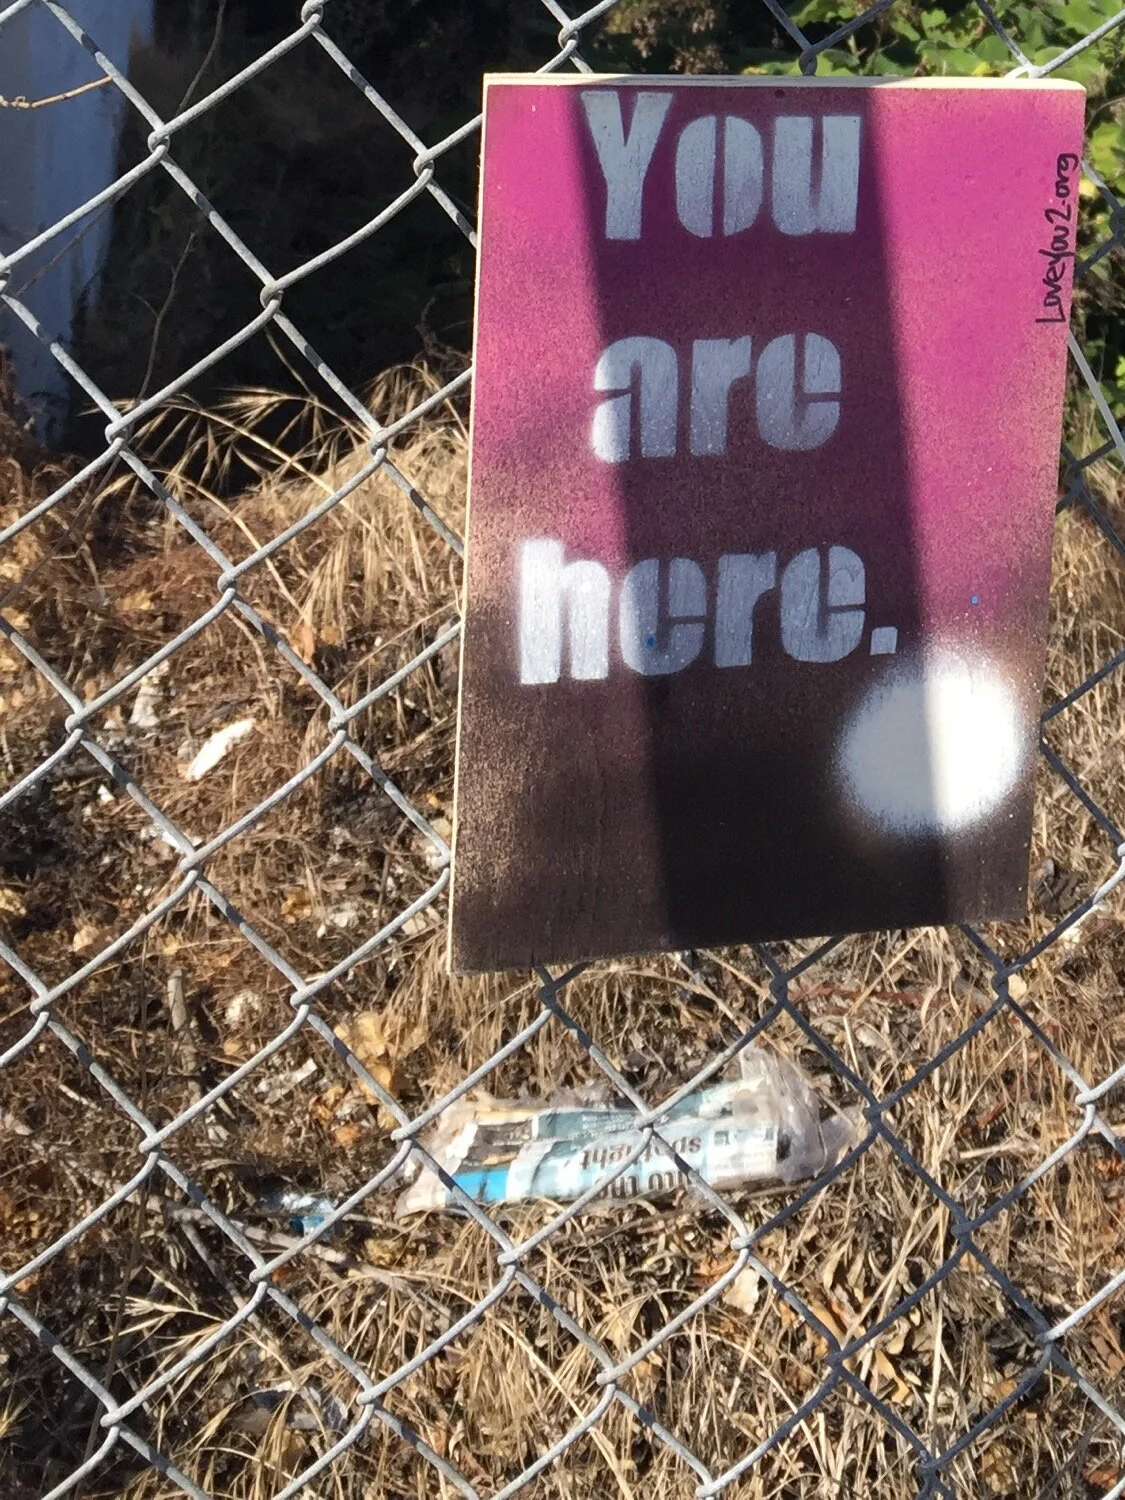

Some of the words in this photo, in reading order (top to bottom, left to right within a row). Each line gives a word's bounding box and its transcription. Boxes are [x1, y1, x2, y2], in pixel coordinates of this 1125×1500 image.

[579, 90, 862, 242] You
[590, 331, 842, 465] are
[518, 536, 898, 686] here.
[581, 1136, 702, 1170] sptight
